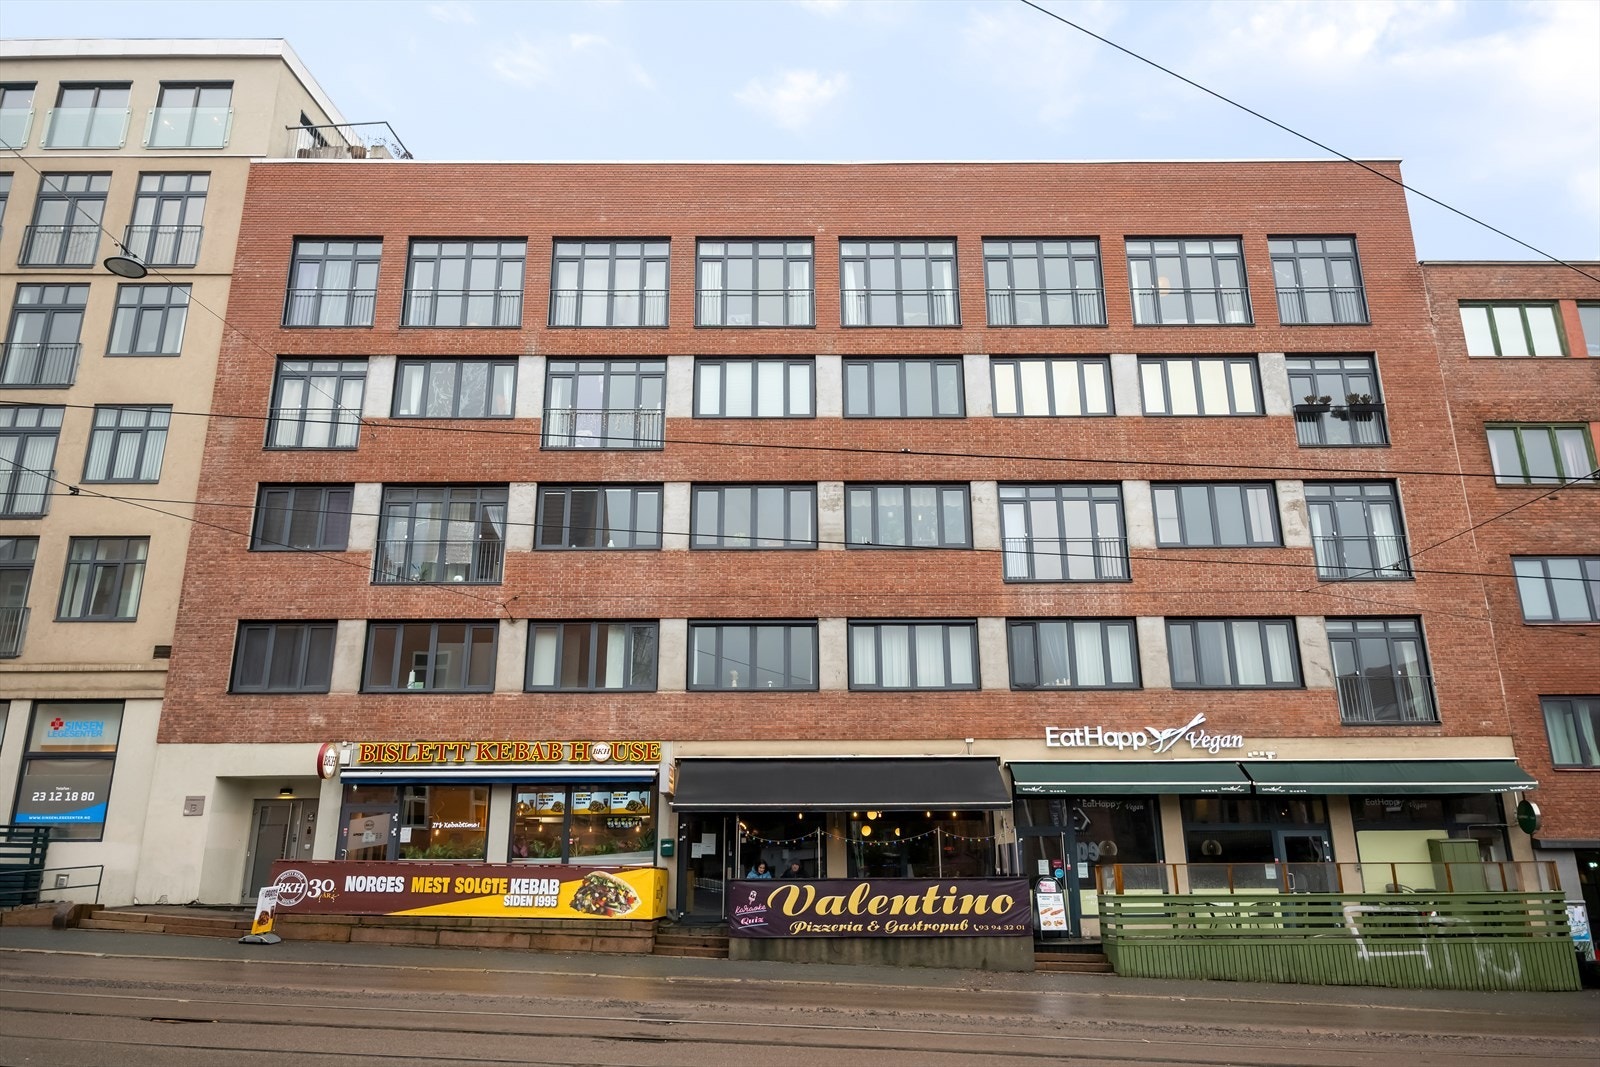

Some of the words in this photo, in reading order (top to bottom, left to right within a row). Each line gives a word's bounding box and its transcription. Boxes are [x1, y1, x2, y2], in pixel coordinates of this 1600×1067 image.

[64, 720, 105, 731] SINSEN
[47, 729, 104, 738] LEGESENTER
[1185, 729, 1244, 754] Vegan
[357, 741, 471, 764] BISLETT
[474, 741, 565, 764] KEBAB
[323, 755, 337, 767] BKH
[32, 792, 46, 801] 23
[48, 792, 62, 801] 12
[65, 792, 78, 801] 18
[80, 792, 95, 801] 80
[278, 882, 306, 893] BKH
[307, 878, 335, 898] 30
[344, 875, 405, 893] NORGES
[411, 876, 450, 894] MEST
[454, 876, 508, 894] SOLGTE
[509, 878, 560, 895] KEBAB
[503, 894, 533, 907] SIDEN
[534, 895, 558, 907] 1995
[766, 882, 1016, 917] Valentino
[735, 903, 767, 914] Karaoke
[740, 916, 764, 925] Quiz
[789, 920, 863, 936] Pizzeria
[867, 920, 880, 931] &
[884, 918, 969, 934] Gastropub
